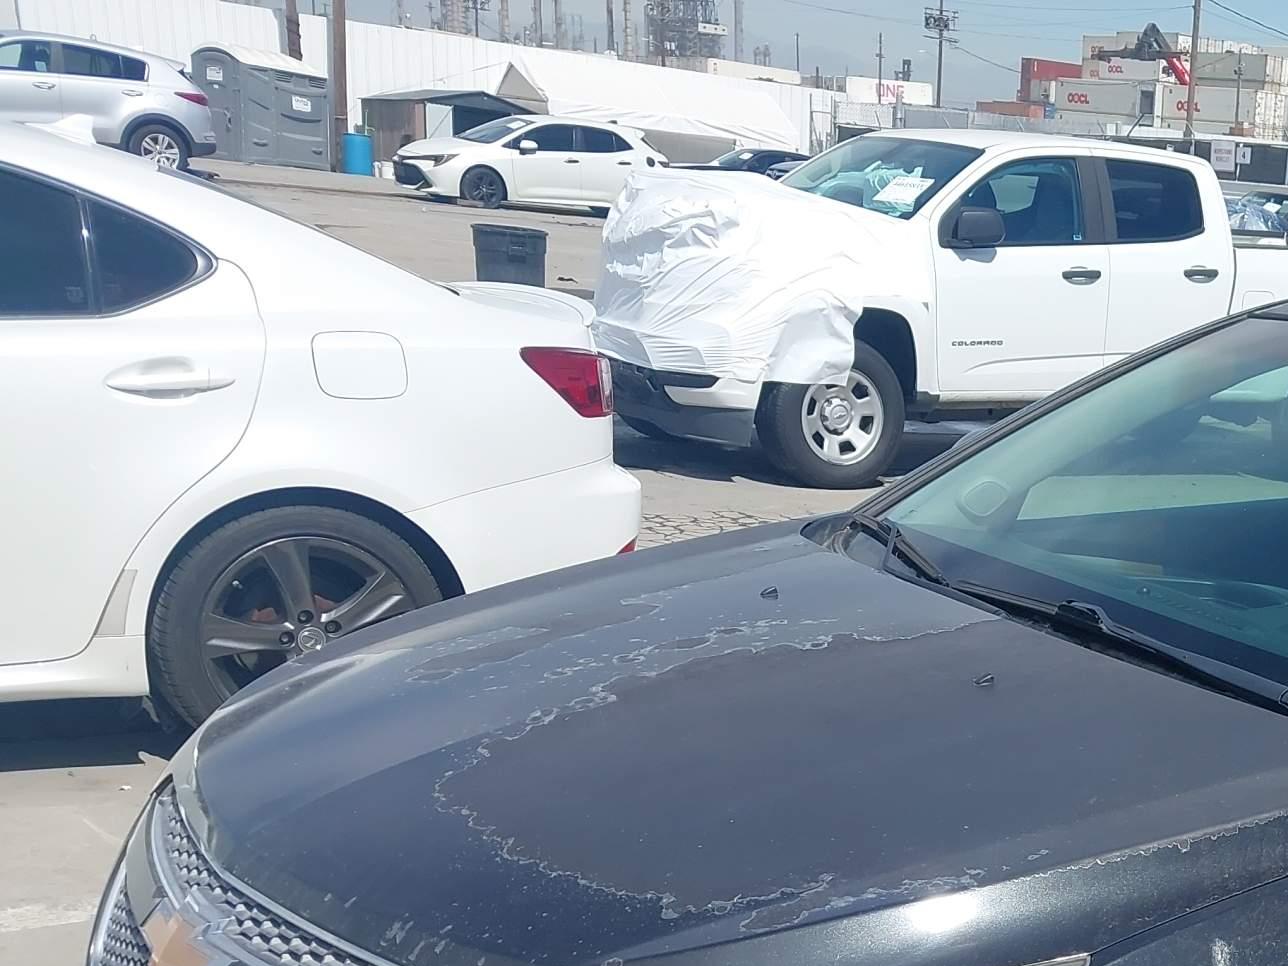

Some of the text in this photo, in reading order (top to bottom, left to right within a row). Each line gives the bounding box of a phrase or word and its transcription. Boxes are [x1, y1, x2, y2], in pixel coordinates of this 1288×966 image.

[1107, 65, 1124, 74] OOCL
[1067, 92, 1090, 105] OOCL
[1176, 100, 1201, 112] OOL
[1241, 151, 1246, 160] 4
